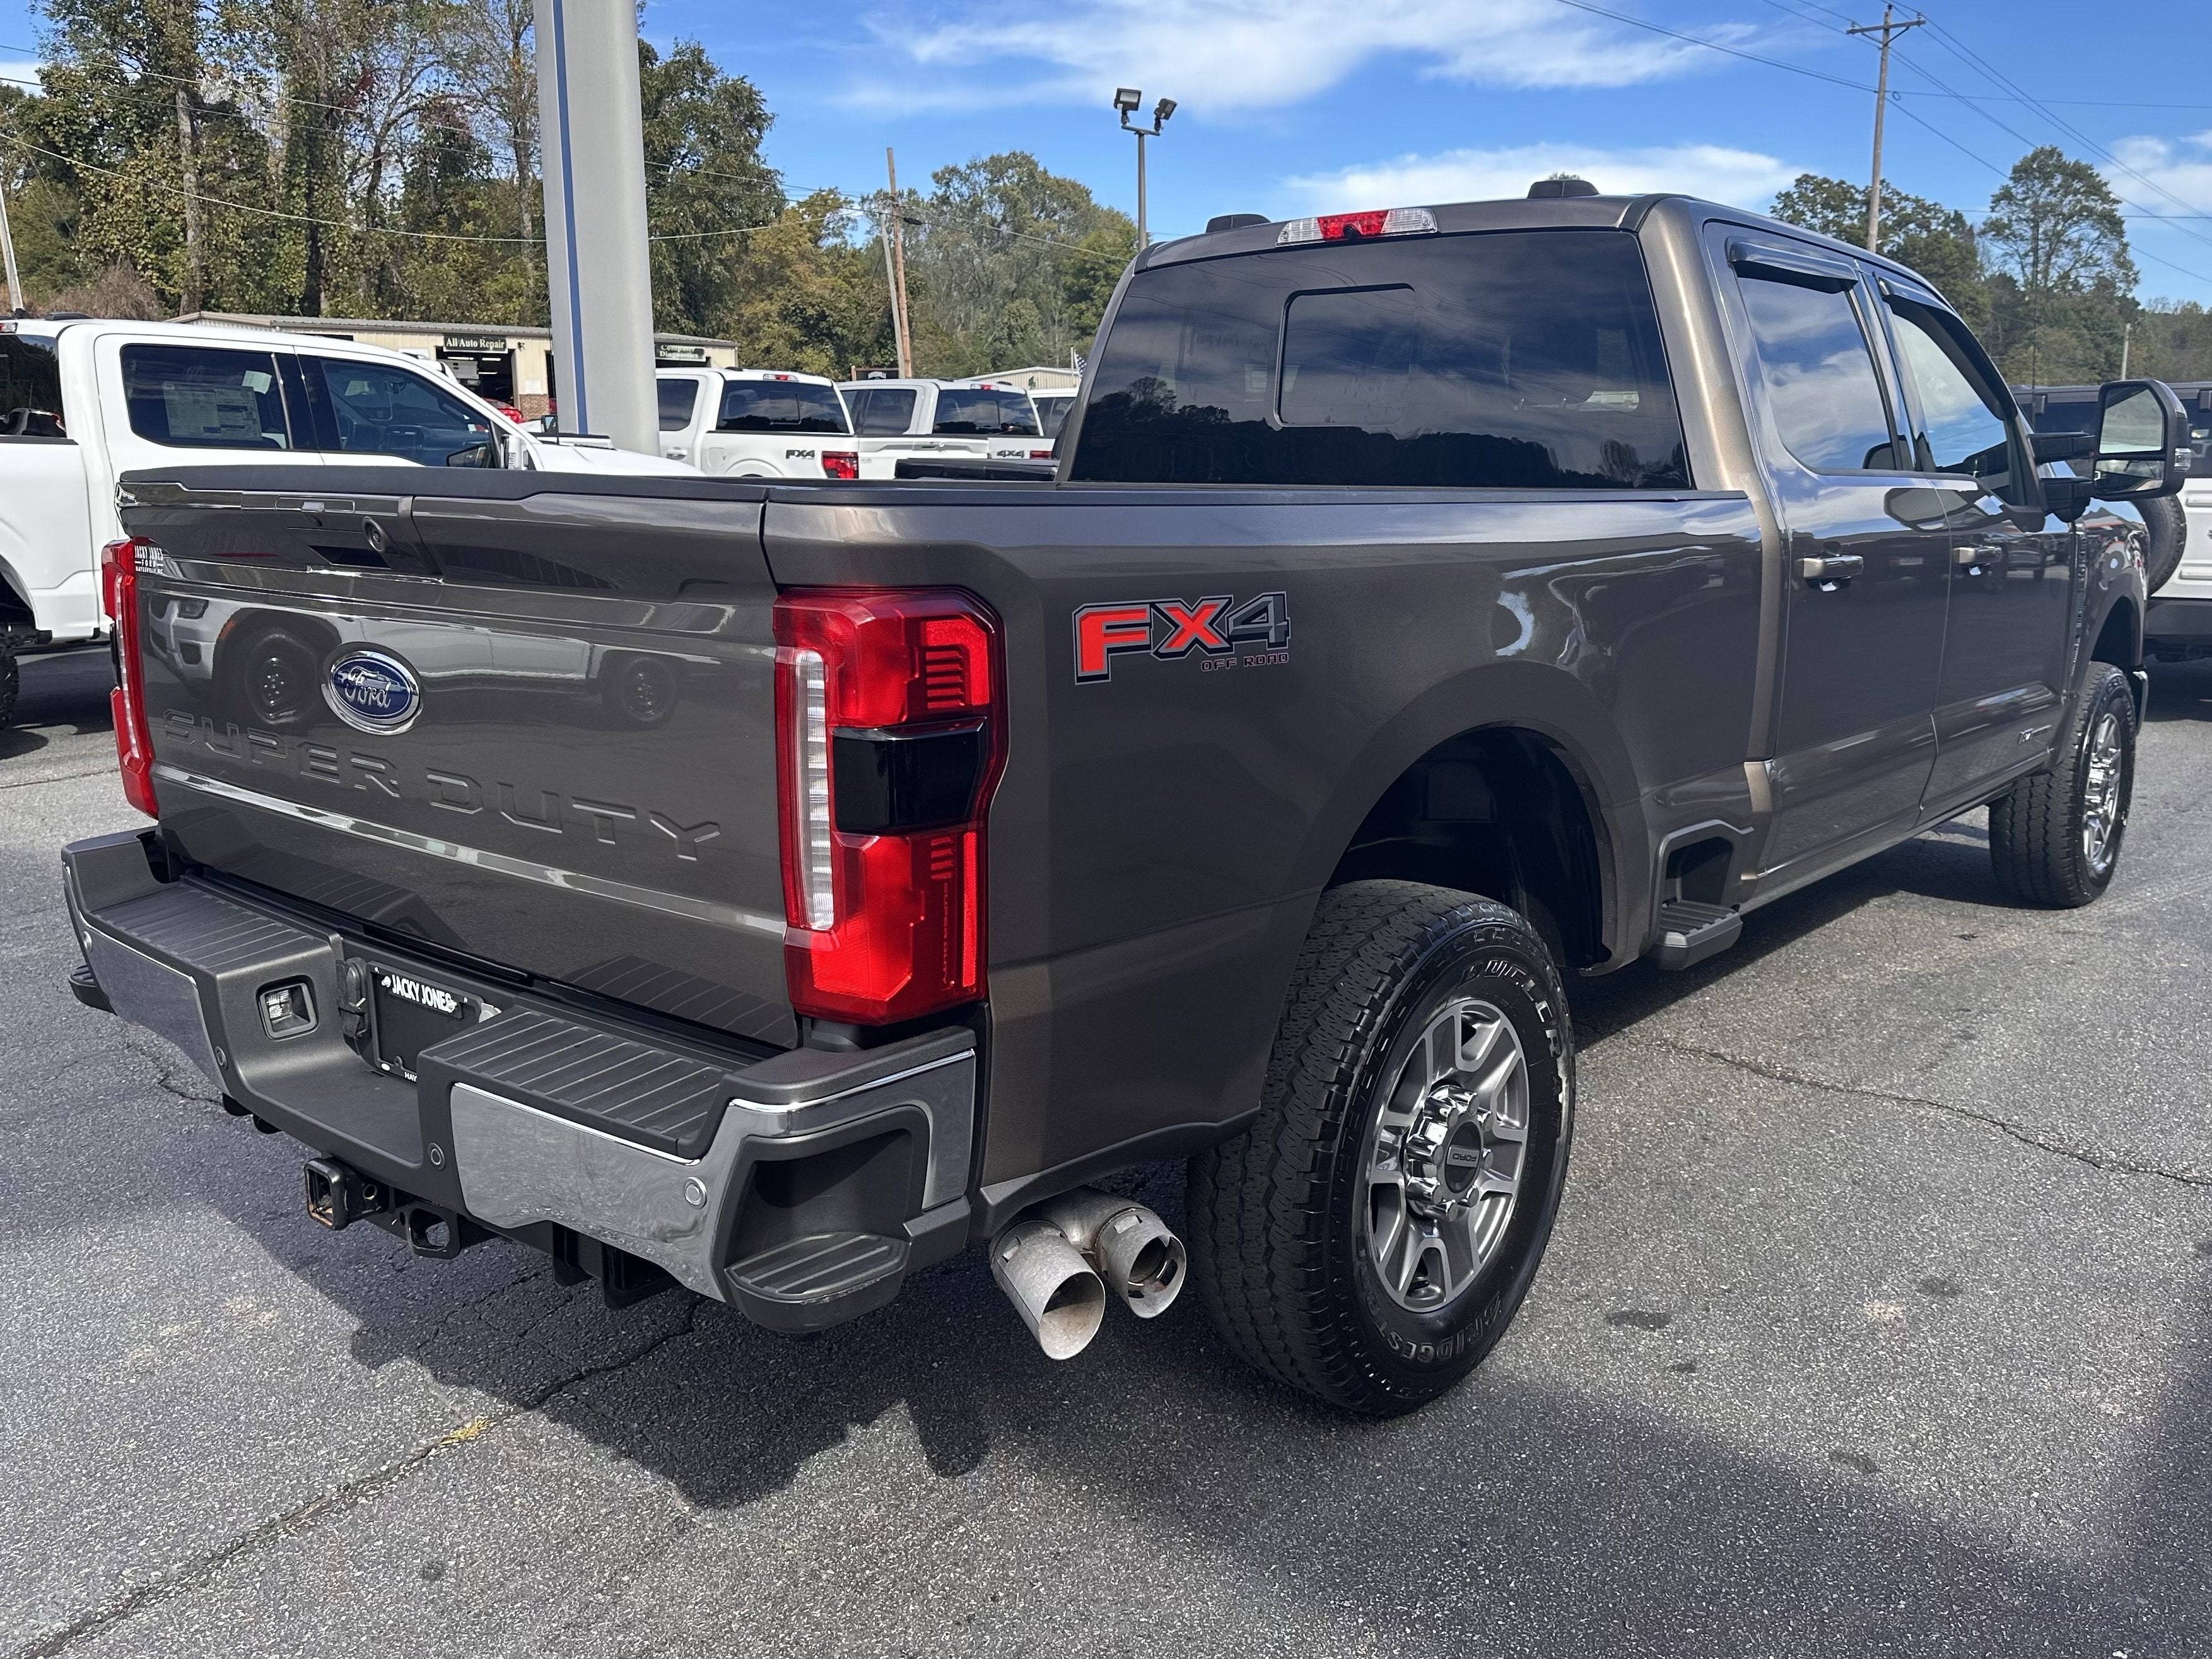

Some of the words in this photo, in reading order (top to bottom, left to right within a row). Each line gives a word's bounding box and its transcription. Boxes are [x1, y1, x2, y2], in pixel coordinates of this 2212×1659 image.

[446, 337, 458, 347] All
[459, 338, 478, 348] Auto
[479, 339, 505, 351] Repair
[660, 344, 694, 353] Computer
[659, 351, 699, 359] Diagnostics
[786, 450, 815, 459] FX4
[134, 545, 148, 560] JACKY
[148, 546, 163, 561] JONES
[141, 559, 156, 567] FORD
[1072, 591, 1291, 686] FX4
[1200, 657, 1238, 672] OFF
[1243, 652, 1289, 668] ROAD
[344, 665, 392, 708] Ford
[161, 707, 400, 798] SUPER
[426, 766, 721, 862] DUTY
[392, 974, 420, 1002] JACKY
[1452, 1152, 1477, 1162] FORD
